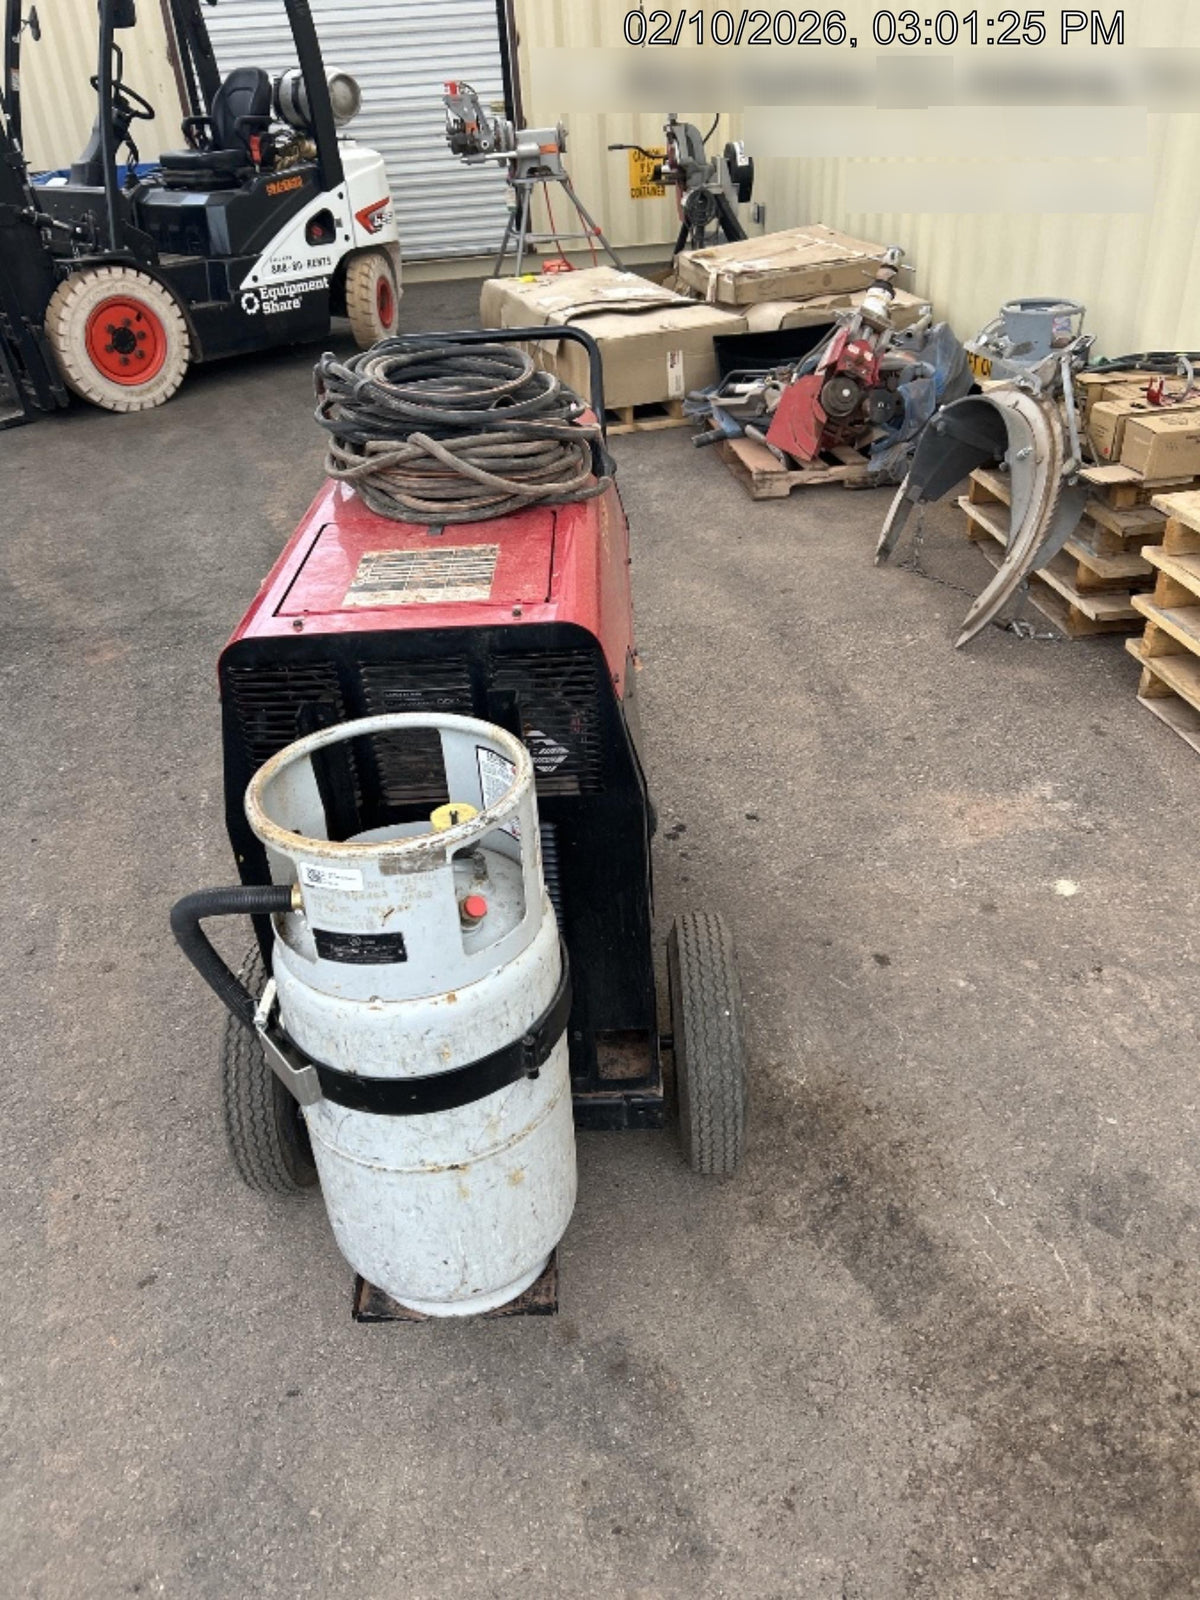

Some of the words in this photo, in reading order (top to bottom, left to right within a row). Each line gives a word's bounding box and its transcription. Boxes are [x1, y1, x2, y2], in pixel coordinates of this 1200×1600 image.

[631, 184, 665, 198] CONTAINER
[306, 256, 331, 269] RENTS
[259, 276, 329, 301] Equipment
[262, 298, 301, 314] Share
